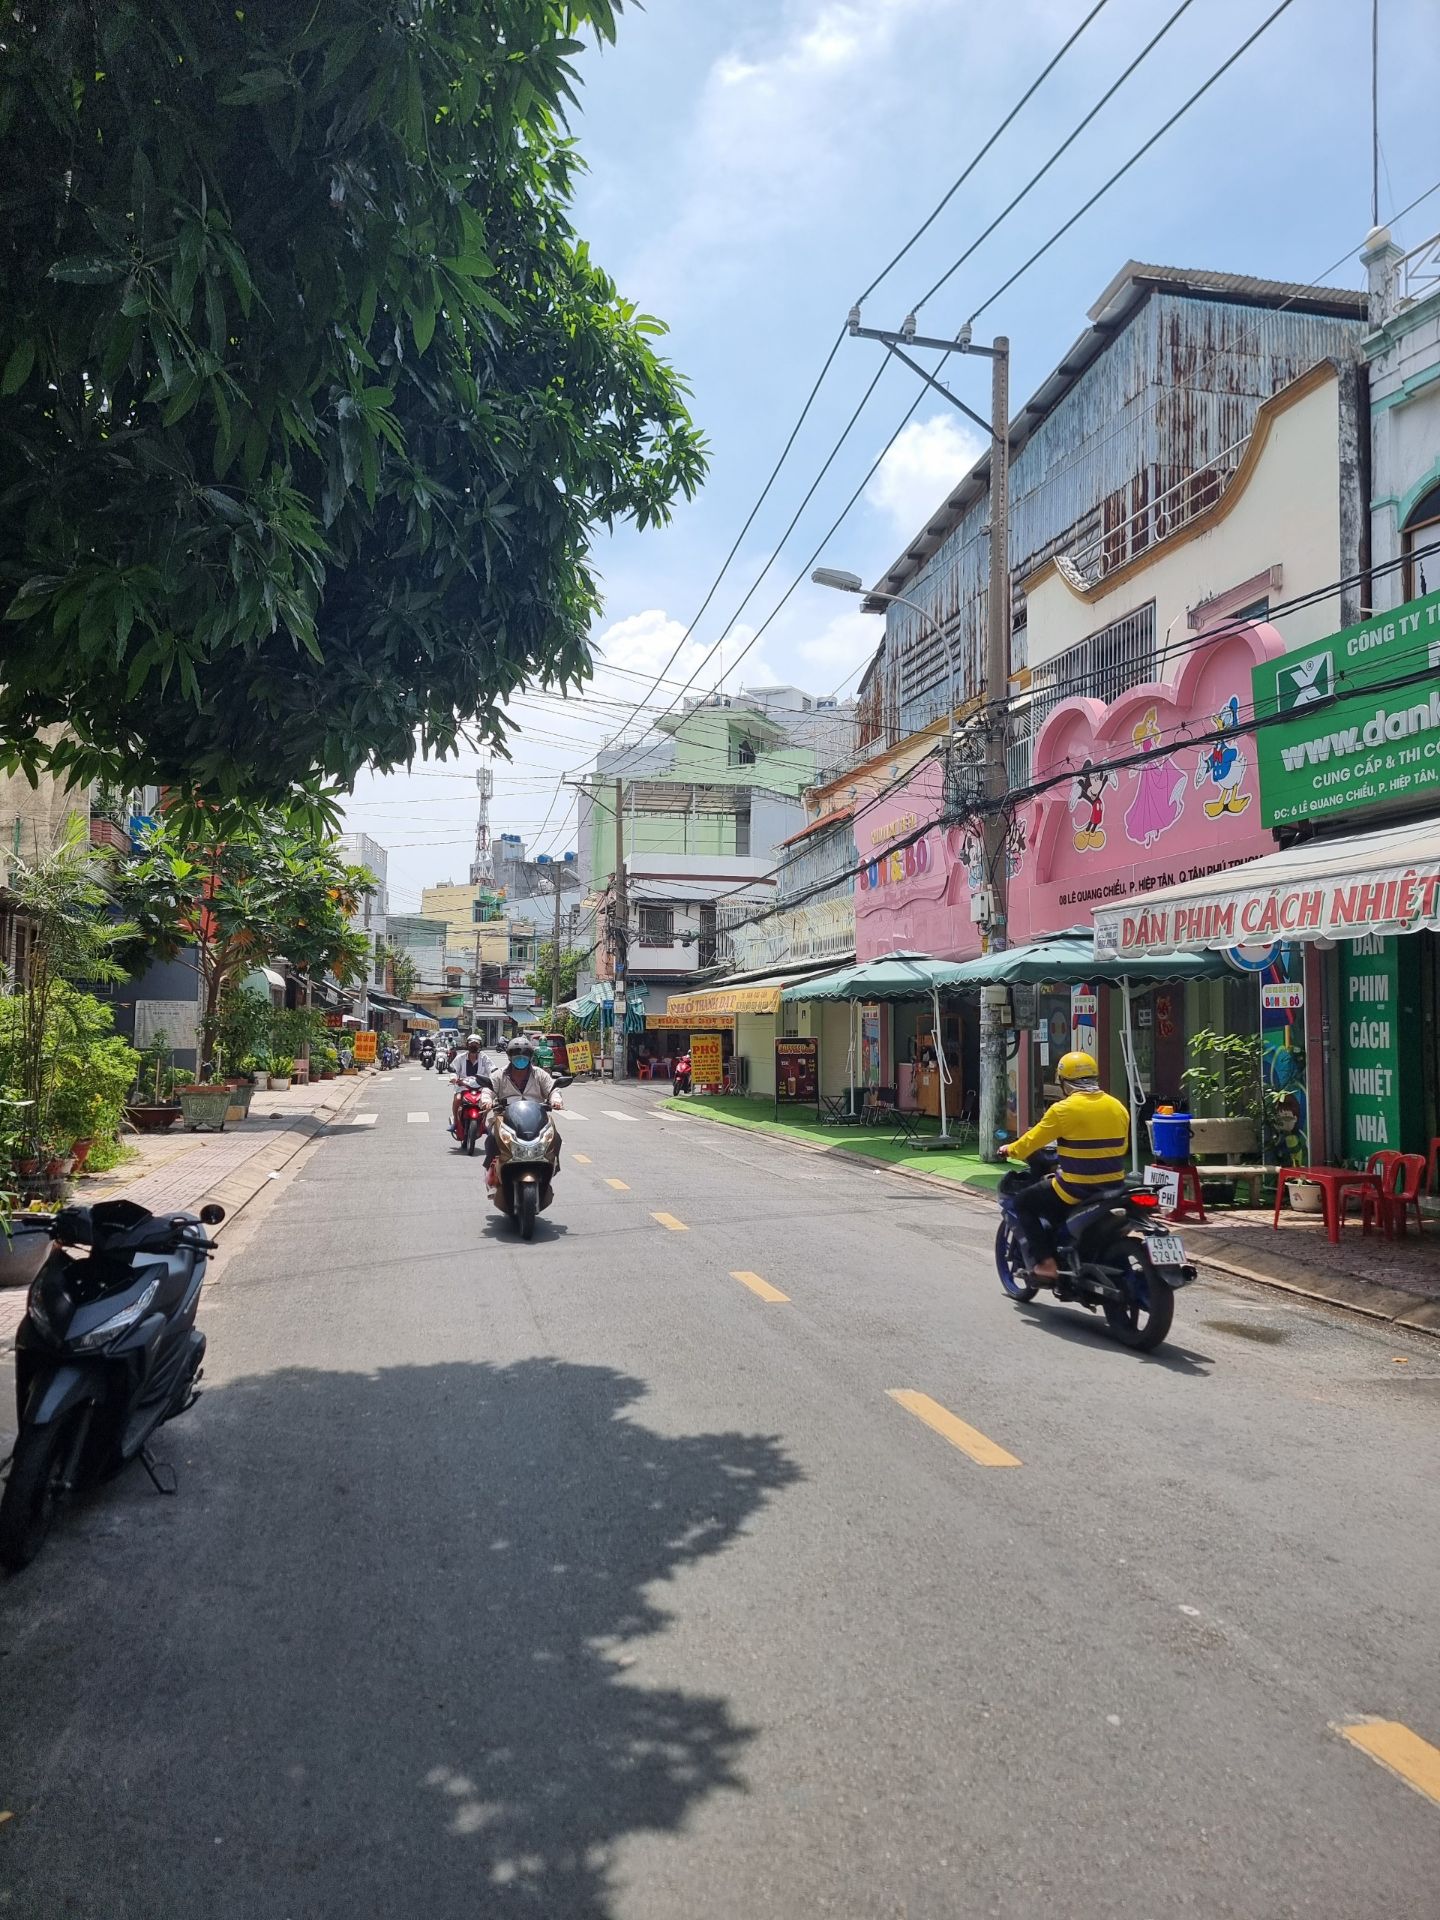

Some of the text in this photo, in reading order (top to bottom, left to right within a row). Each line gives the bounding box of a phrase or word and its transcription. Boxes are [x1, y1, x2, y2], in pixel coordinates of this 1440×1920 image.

[1347, 624, 1395, 656] CÔNG
[1399, 611, 1420, 636] TY
[1313, 768, 1350, 789] CUNG
[1354, 754, 1382, 778] CẤP
[1386, 755, 1395, 769] &
[1399, 747, 1420, 765] THI
[1274, 808, 1290, 820] ĐC:
[1291, 805, 1297, 816] 6
[1299, 800, 1308, 814] LÊ
[1310, 794, 1343, 811] QUANG
[1379, 784, 1387, 794] P.
[1390, 775, 1411, 791] HIỆP
[1414, 769, 1439, 784] TÂN,
[1067, 890, 1077, 903] LÊ
[1077, 888, 1102, 902] QUANG
[1129, 882, 1138, 893] P.
[1138, 876, 1156, 892] HIỆP
[1121, 908, 1168, 948] DÁN
[1174, 902, 1236, 942] PHIM
[1241, 888, 1323, 933] CÁCH
[1329, 869, 1440, 928] NHIỆT
[1350, 975, 1389, 1002] PHIM
[693, 1041, 718, 1054] PHỞ
[1350, 1016, 1389, 1049] CÁCH
[1349, 1063, 1392, 1102] NHIỆT
[1356, 1111, 1388, 1144] NHÀ
[1161, 1191, 1175, 1206] PHÍ
